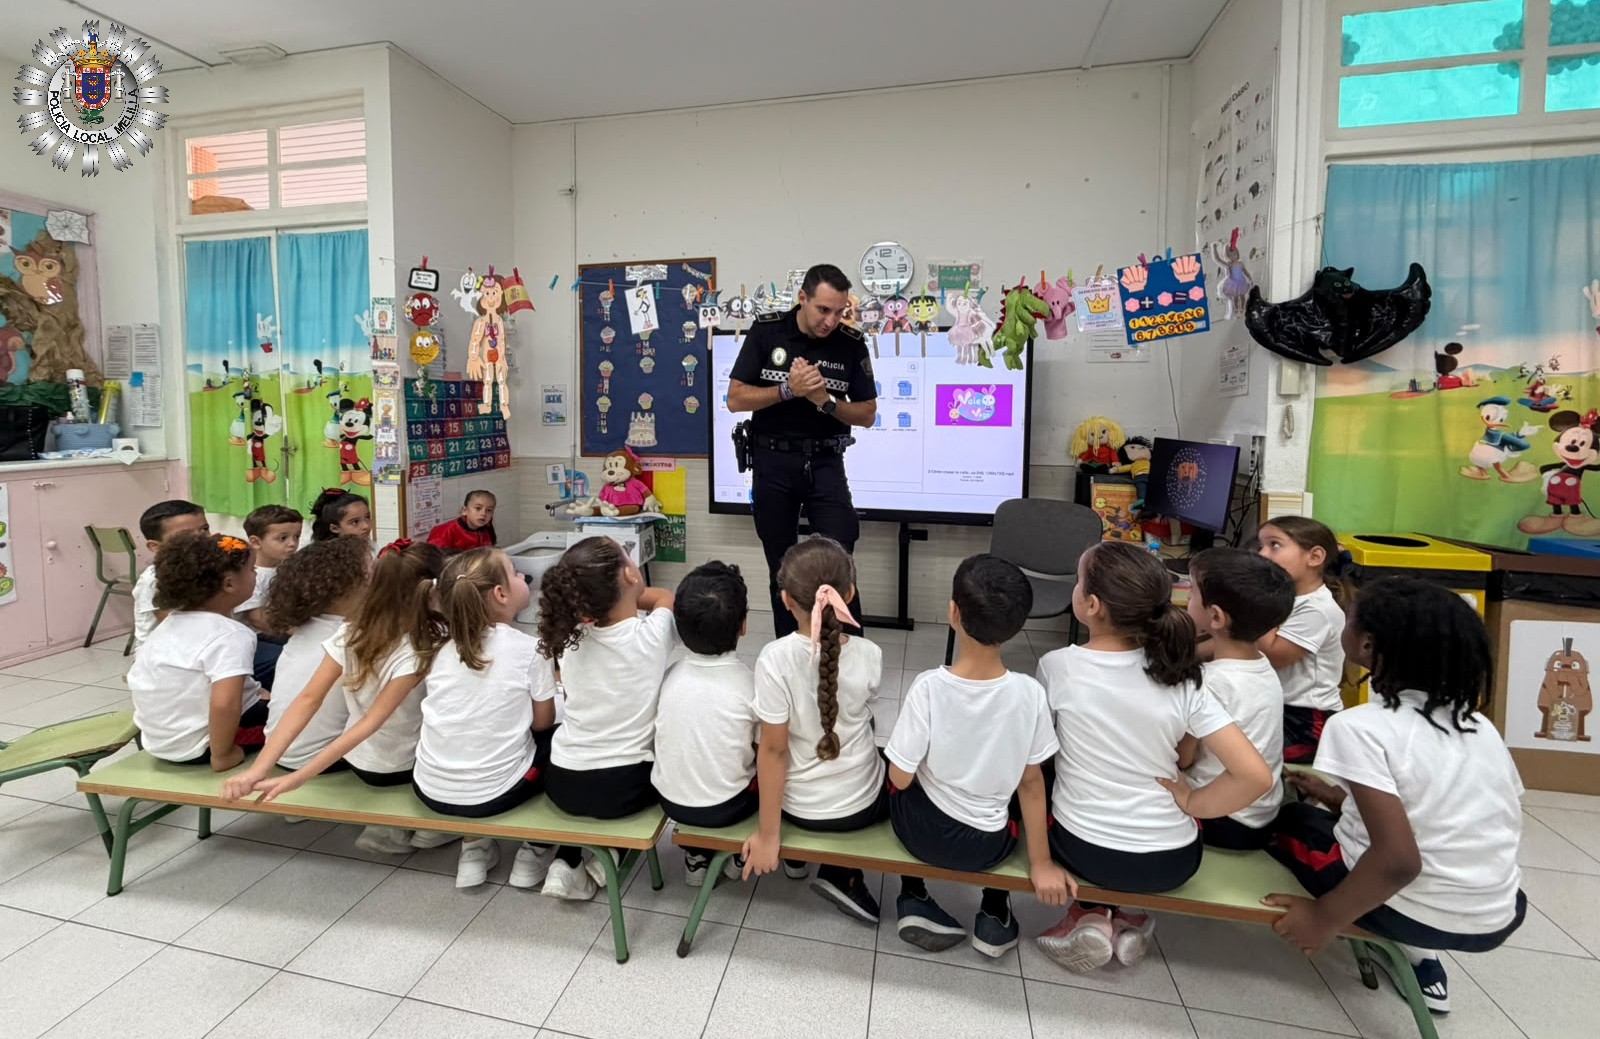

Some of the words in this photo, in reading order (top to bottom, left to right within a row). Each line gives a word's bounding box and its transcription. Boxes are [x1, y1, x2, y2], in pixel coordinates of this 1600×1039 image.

[879, 248, 892, 258] 12
[864, 265, 875, 275] 9
[897, 263, 907, 273] 3
[1136, 331, 1144, 340] 6
[1157, 326, 1166, 335] 8
[449, 383, 456, 395] 3
[412, 403, 419, 415] 7
[430, 403, 438, 415] 8
[449, 403, 456, 415] 9
[464, 403, 473, 413] 10
[411, 424, 423, 435] 13
[430, 423, 440, 434] 14
[449, 422, 459, 433] 15
[464, 421, 474, 432] 16
[480, 420, 488, 431] 17
[412, 445, 424, 456] 19
[431, 443, 442, 454] 20
[449, 441, 460, 452] 21
[465, 440, 476, 451] 22
[480, 438, 492, 449] 23
[497, 437, 507, 447] 24
[412, 465, 426, 477] 25
[431, 463, 444, 474] 26
[449, 461, 461, 472] 27
[466, 458, 478, 469] 28
[482, 456, 493, 467] 29
[498, 454, 508, 465] 30
